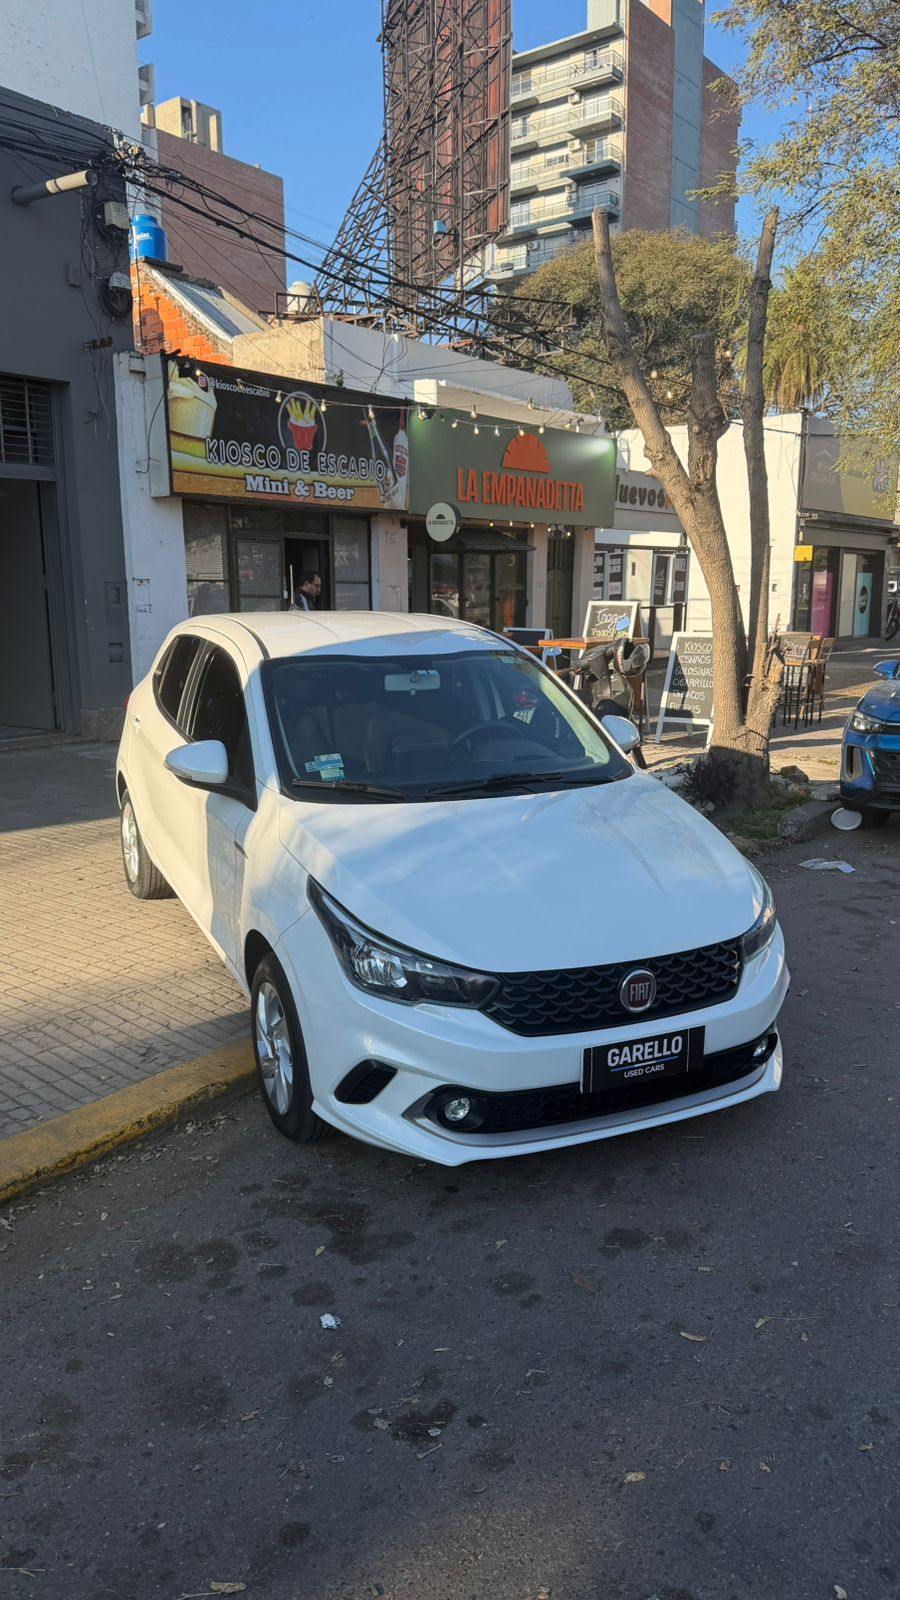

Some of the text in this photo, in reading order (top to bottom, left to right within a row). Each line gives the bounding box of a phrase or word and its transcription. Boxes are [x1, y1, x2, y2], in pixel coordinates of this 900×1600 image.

[205, 438, 281, 469] KIOSCO
[287, 448, 310, 473] DE
[317, 451, 386, 482] ESCABIO
[244, 473, 355, 501] Mini & Beer
[457, 467, 585, 512] LA EMPANADETTA
[595, 608, 627, 629] Trago
[629, 982, 650, 1002] FIAT
[607, 1035, 683, 1067] GARELLO
[624, 1063, 665, 1078] USED CARS
